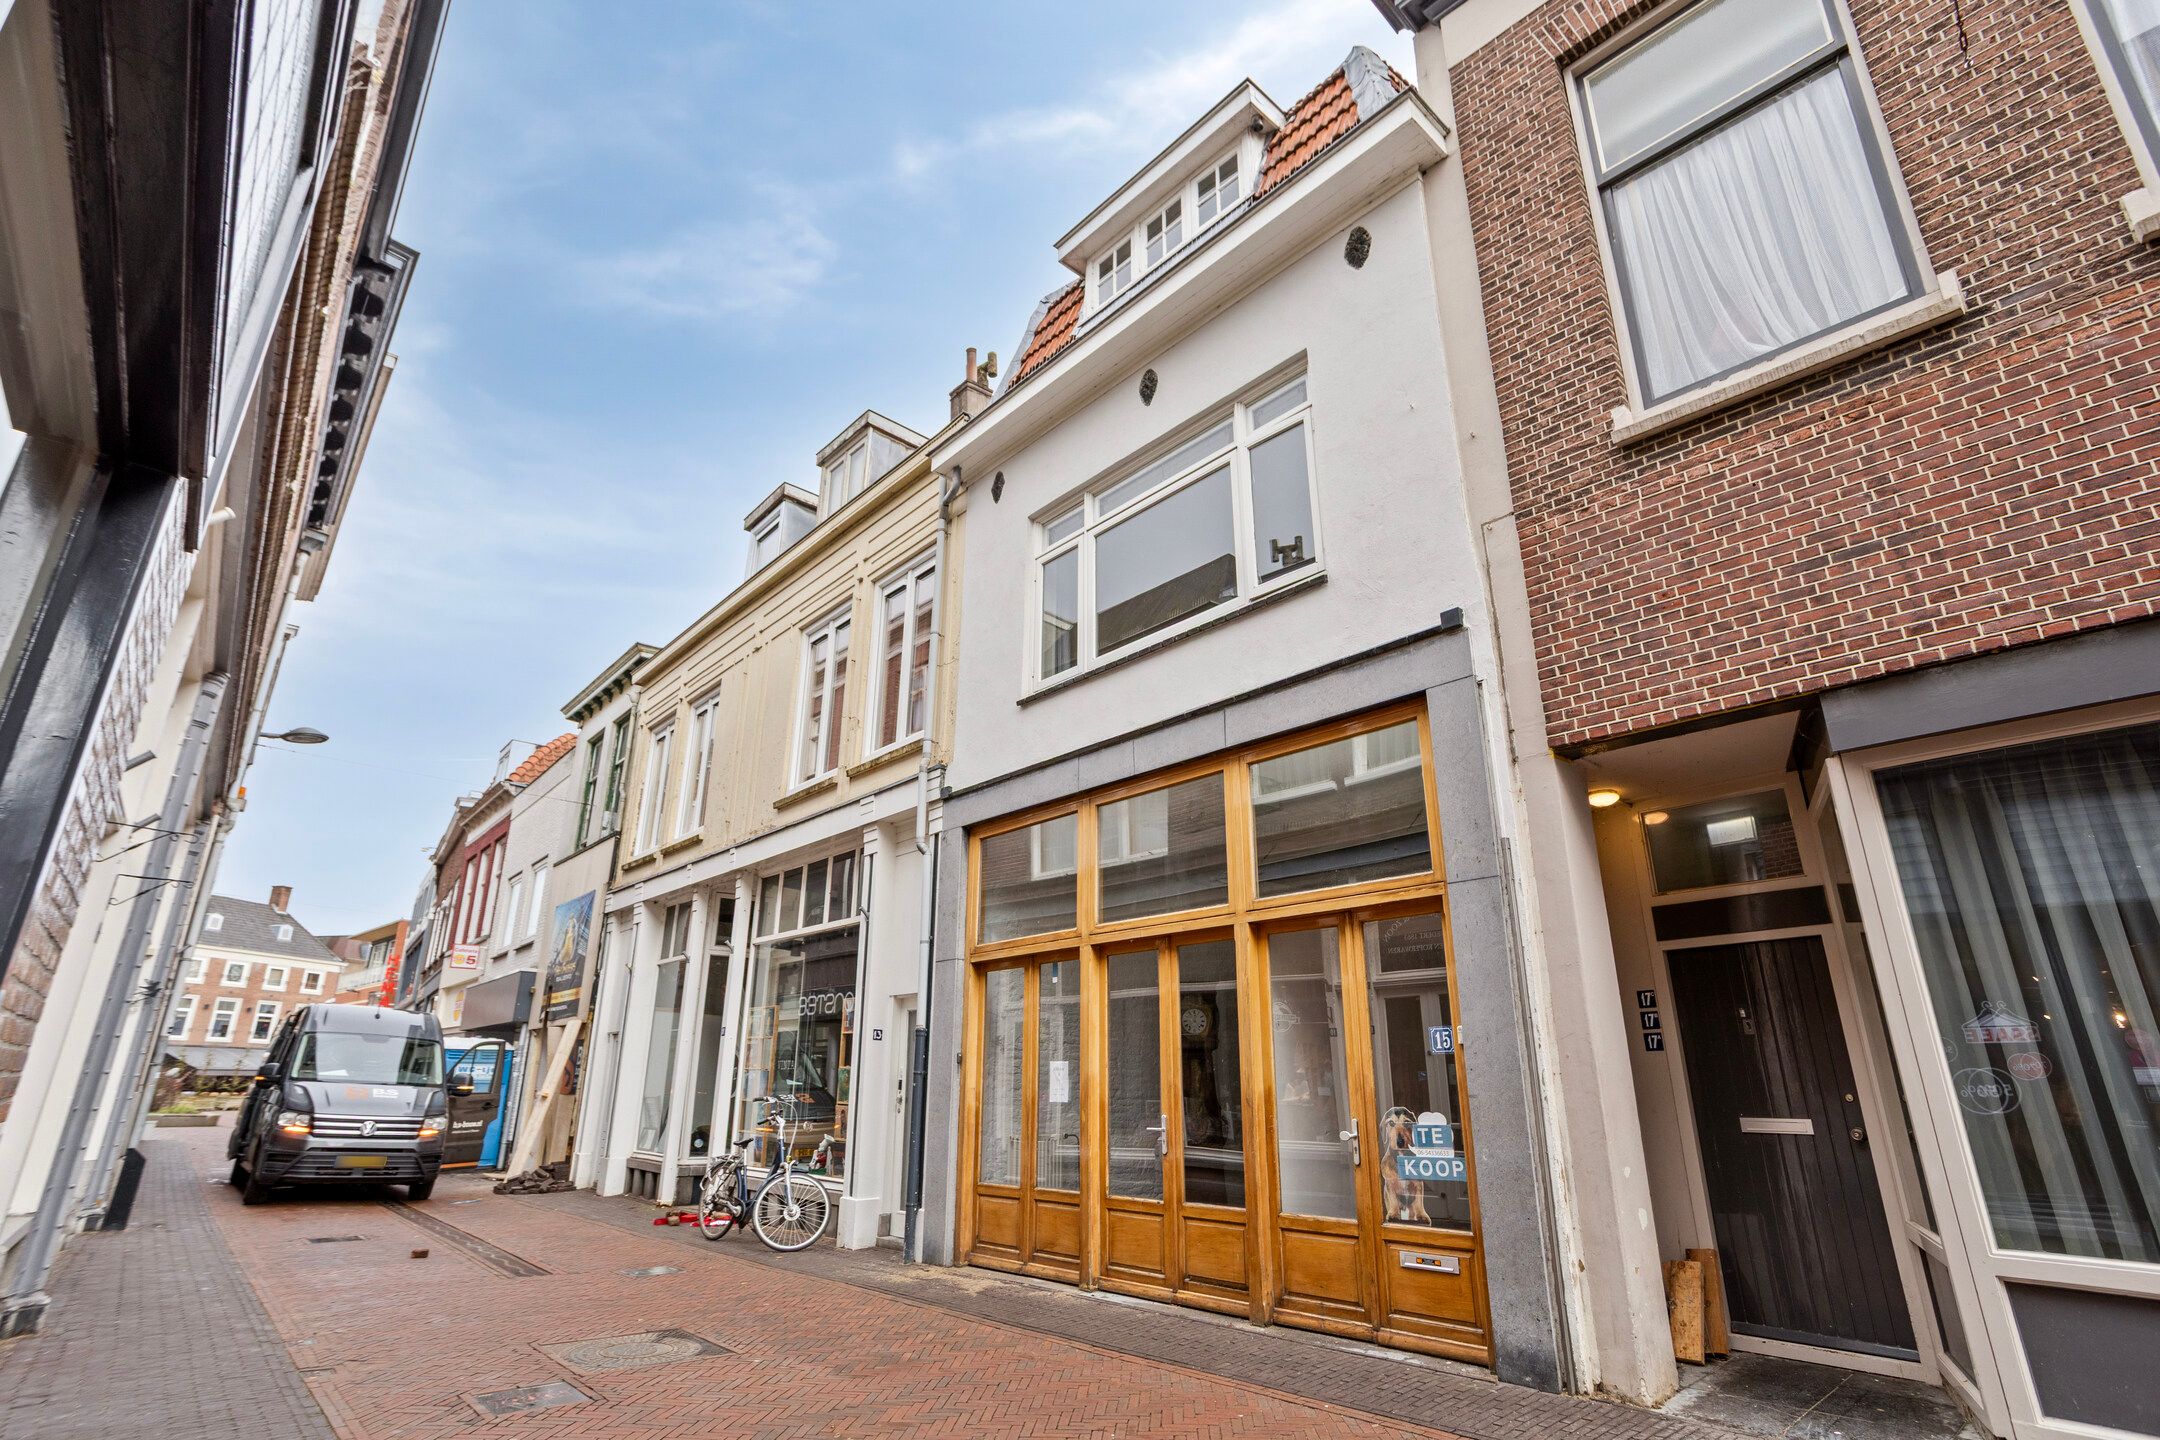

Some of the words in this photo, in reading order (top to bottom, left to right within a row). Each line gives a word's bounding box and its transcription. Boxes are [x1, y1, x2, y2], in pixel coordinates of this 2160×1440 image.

[1434, 1031, 1450, 1049] 15
[372, 1088, 399, 1096] BS
[1417, 1127, 1444, 1144] TE
[1404, 1159, 1464, 1177] KOOP
